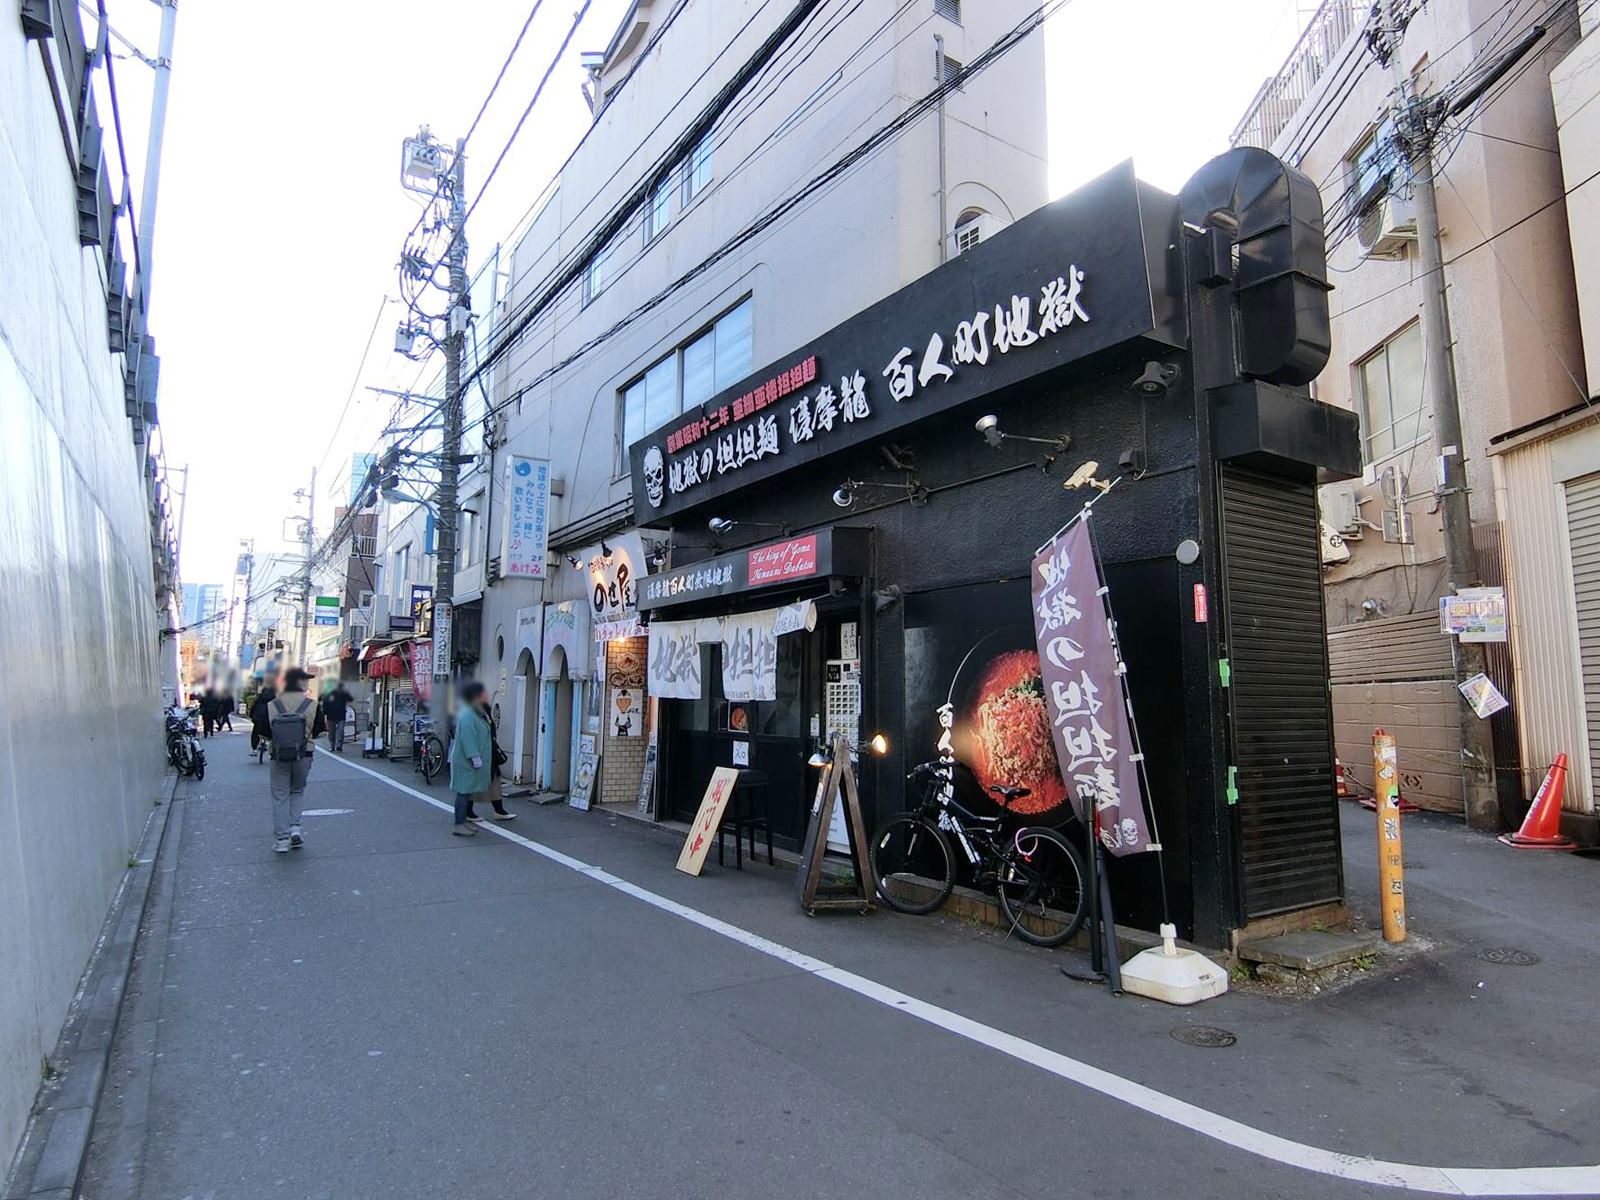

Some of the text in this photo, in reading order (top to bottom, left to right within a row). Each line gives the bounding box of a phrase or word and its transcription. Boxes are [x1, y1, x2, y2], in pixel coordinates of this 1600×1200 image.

[883, 264, 1091, 402] 百人町地獄
[509, 562, 542, 575] あけみ
